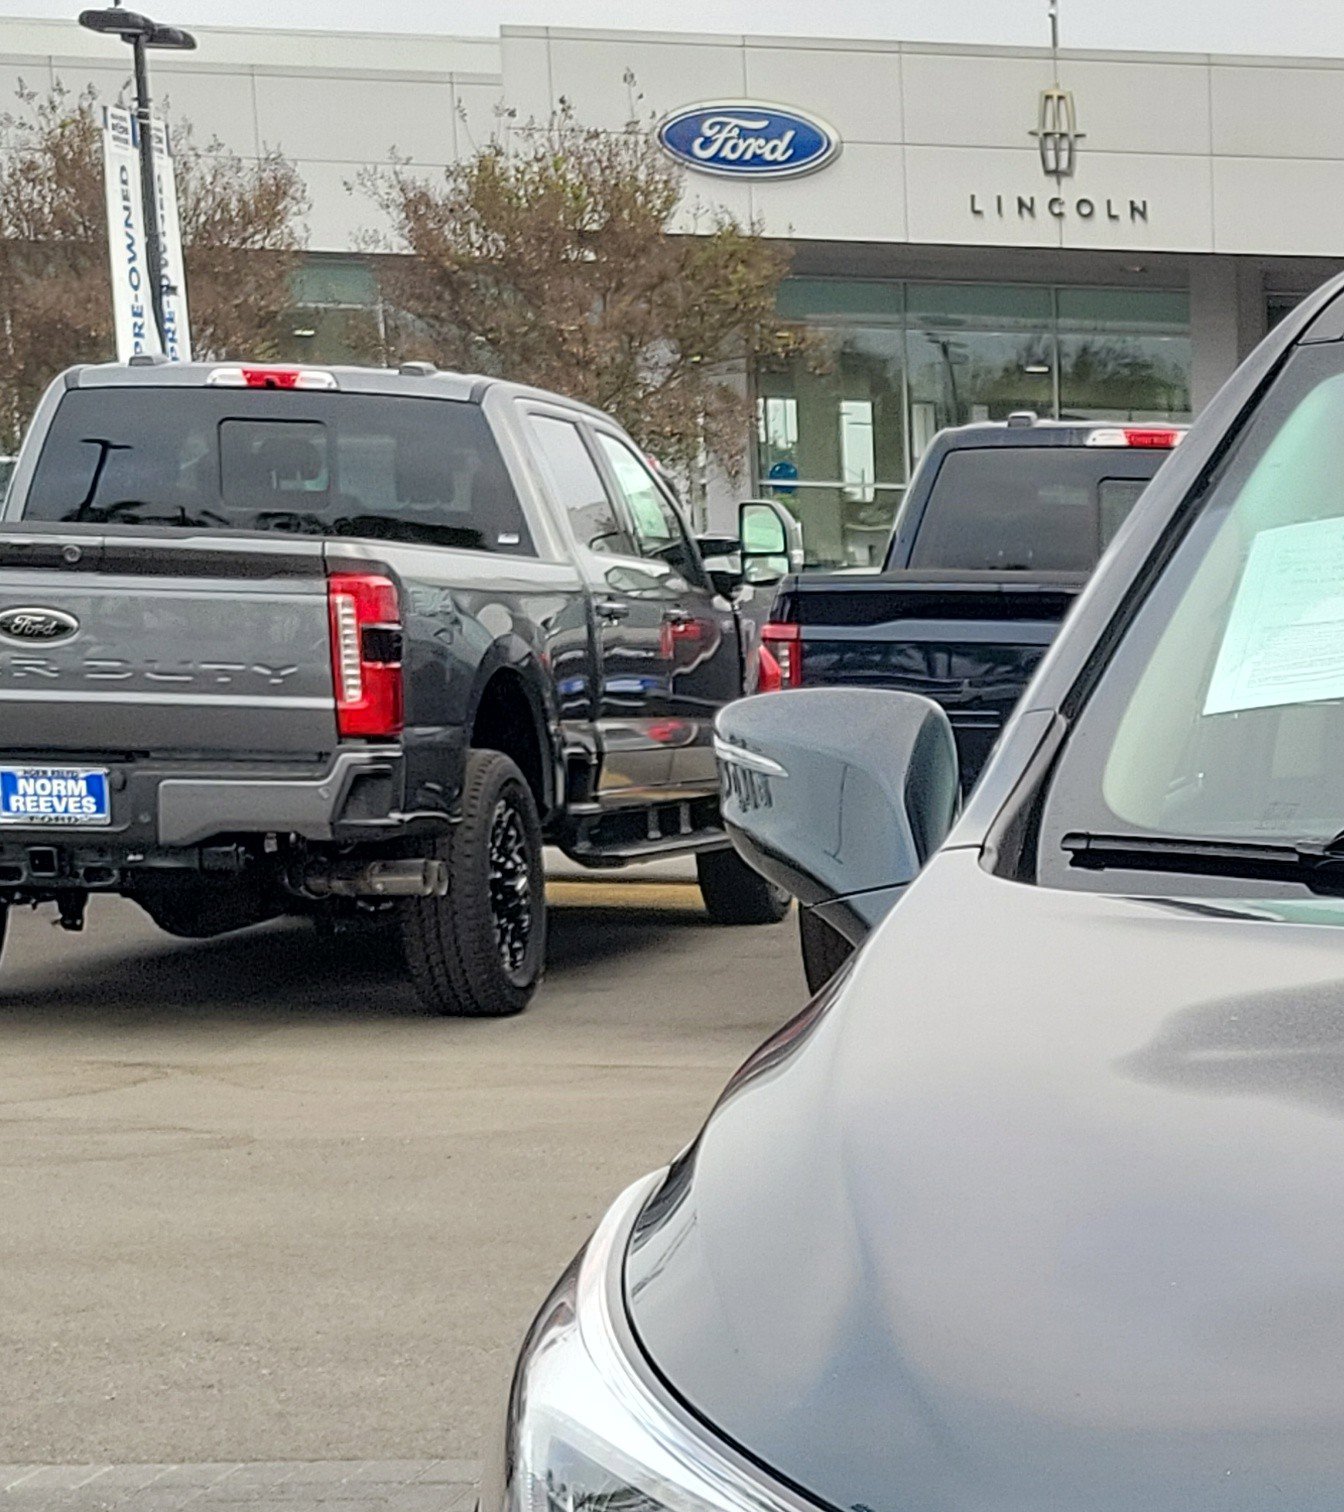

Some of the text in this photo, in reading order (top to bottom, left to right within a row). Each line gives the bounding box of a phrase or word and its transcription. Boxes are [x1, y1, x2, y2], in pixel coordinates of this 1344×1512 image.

[692, 116, 796, 162] Ford
[970, 194, 1148, 222] LINCOLN
[119, 164, 146, 356] PRE-OWNED
[11, 614, 59, 637] Ford
[82, 656, 299, 684] DUTY
[17, 777, 88, 797] NORM
[8, 794, 98, 814] REEVES
